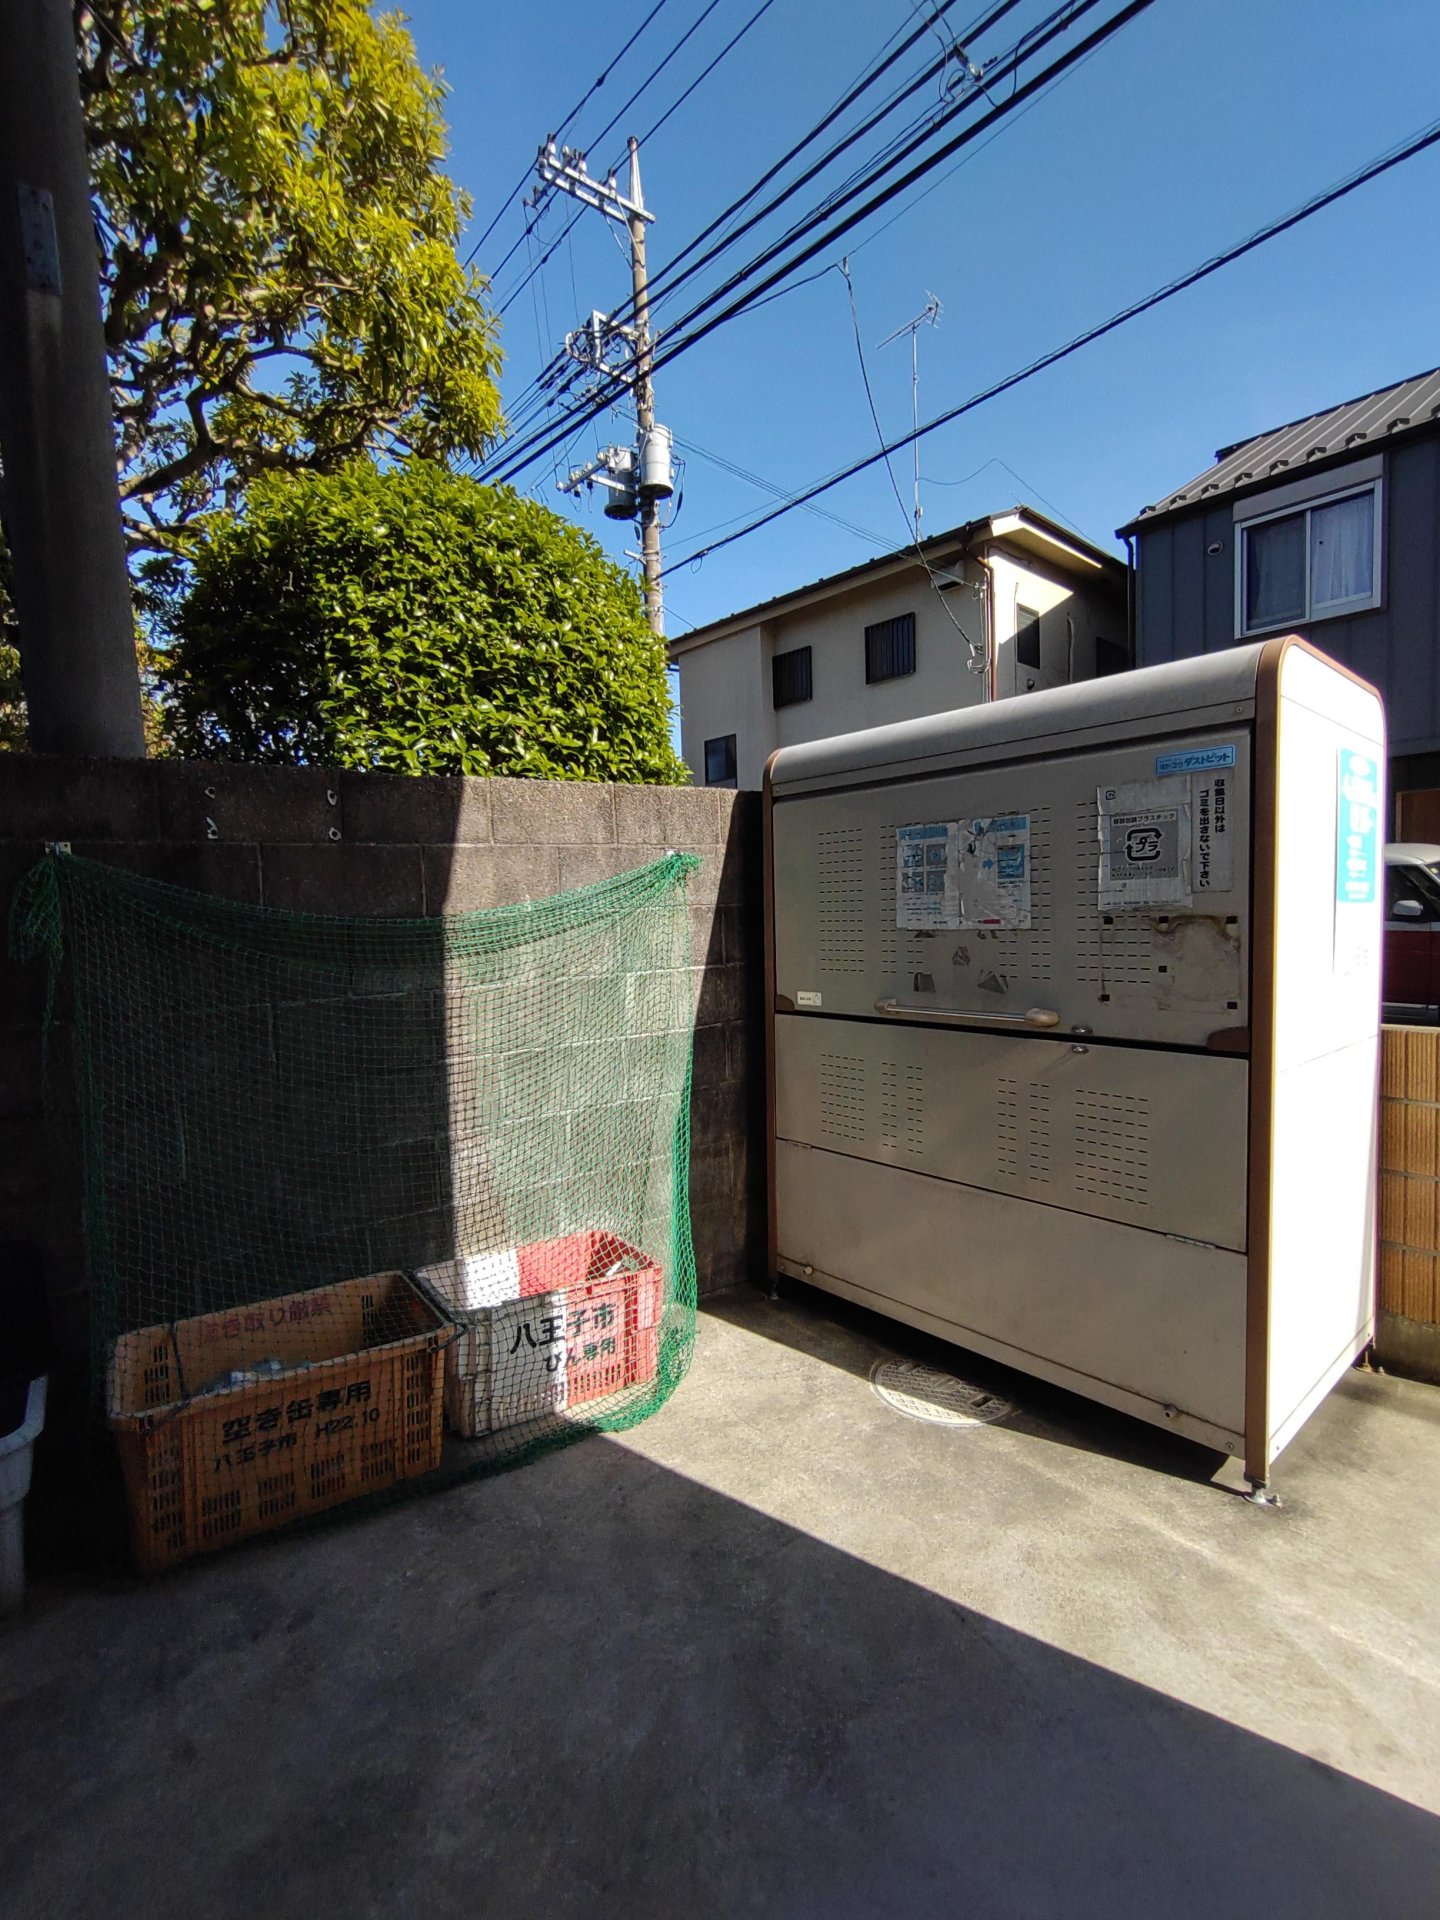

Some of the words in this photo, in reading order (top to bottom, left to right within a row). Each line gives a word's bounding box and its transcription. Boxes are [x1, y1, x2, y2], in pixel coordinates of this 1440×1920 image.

[1135, 836, 1159, 853] プラ
[1199, 789, 1210, 887] ゴミを出さないで下さい
[510, 1302, 616, 1355] 八王子市
[545, 1337, 616, 1373] びん専用
[222, 1380, 372, 1444] 空き缶専用
[316, 1408, 380, 1437] H22.10
